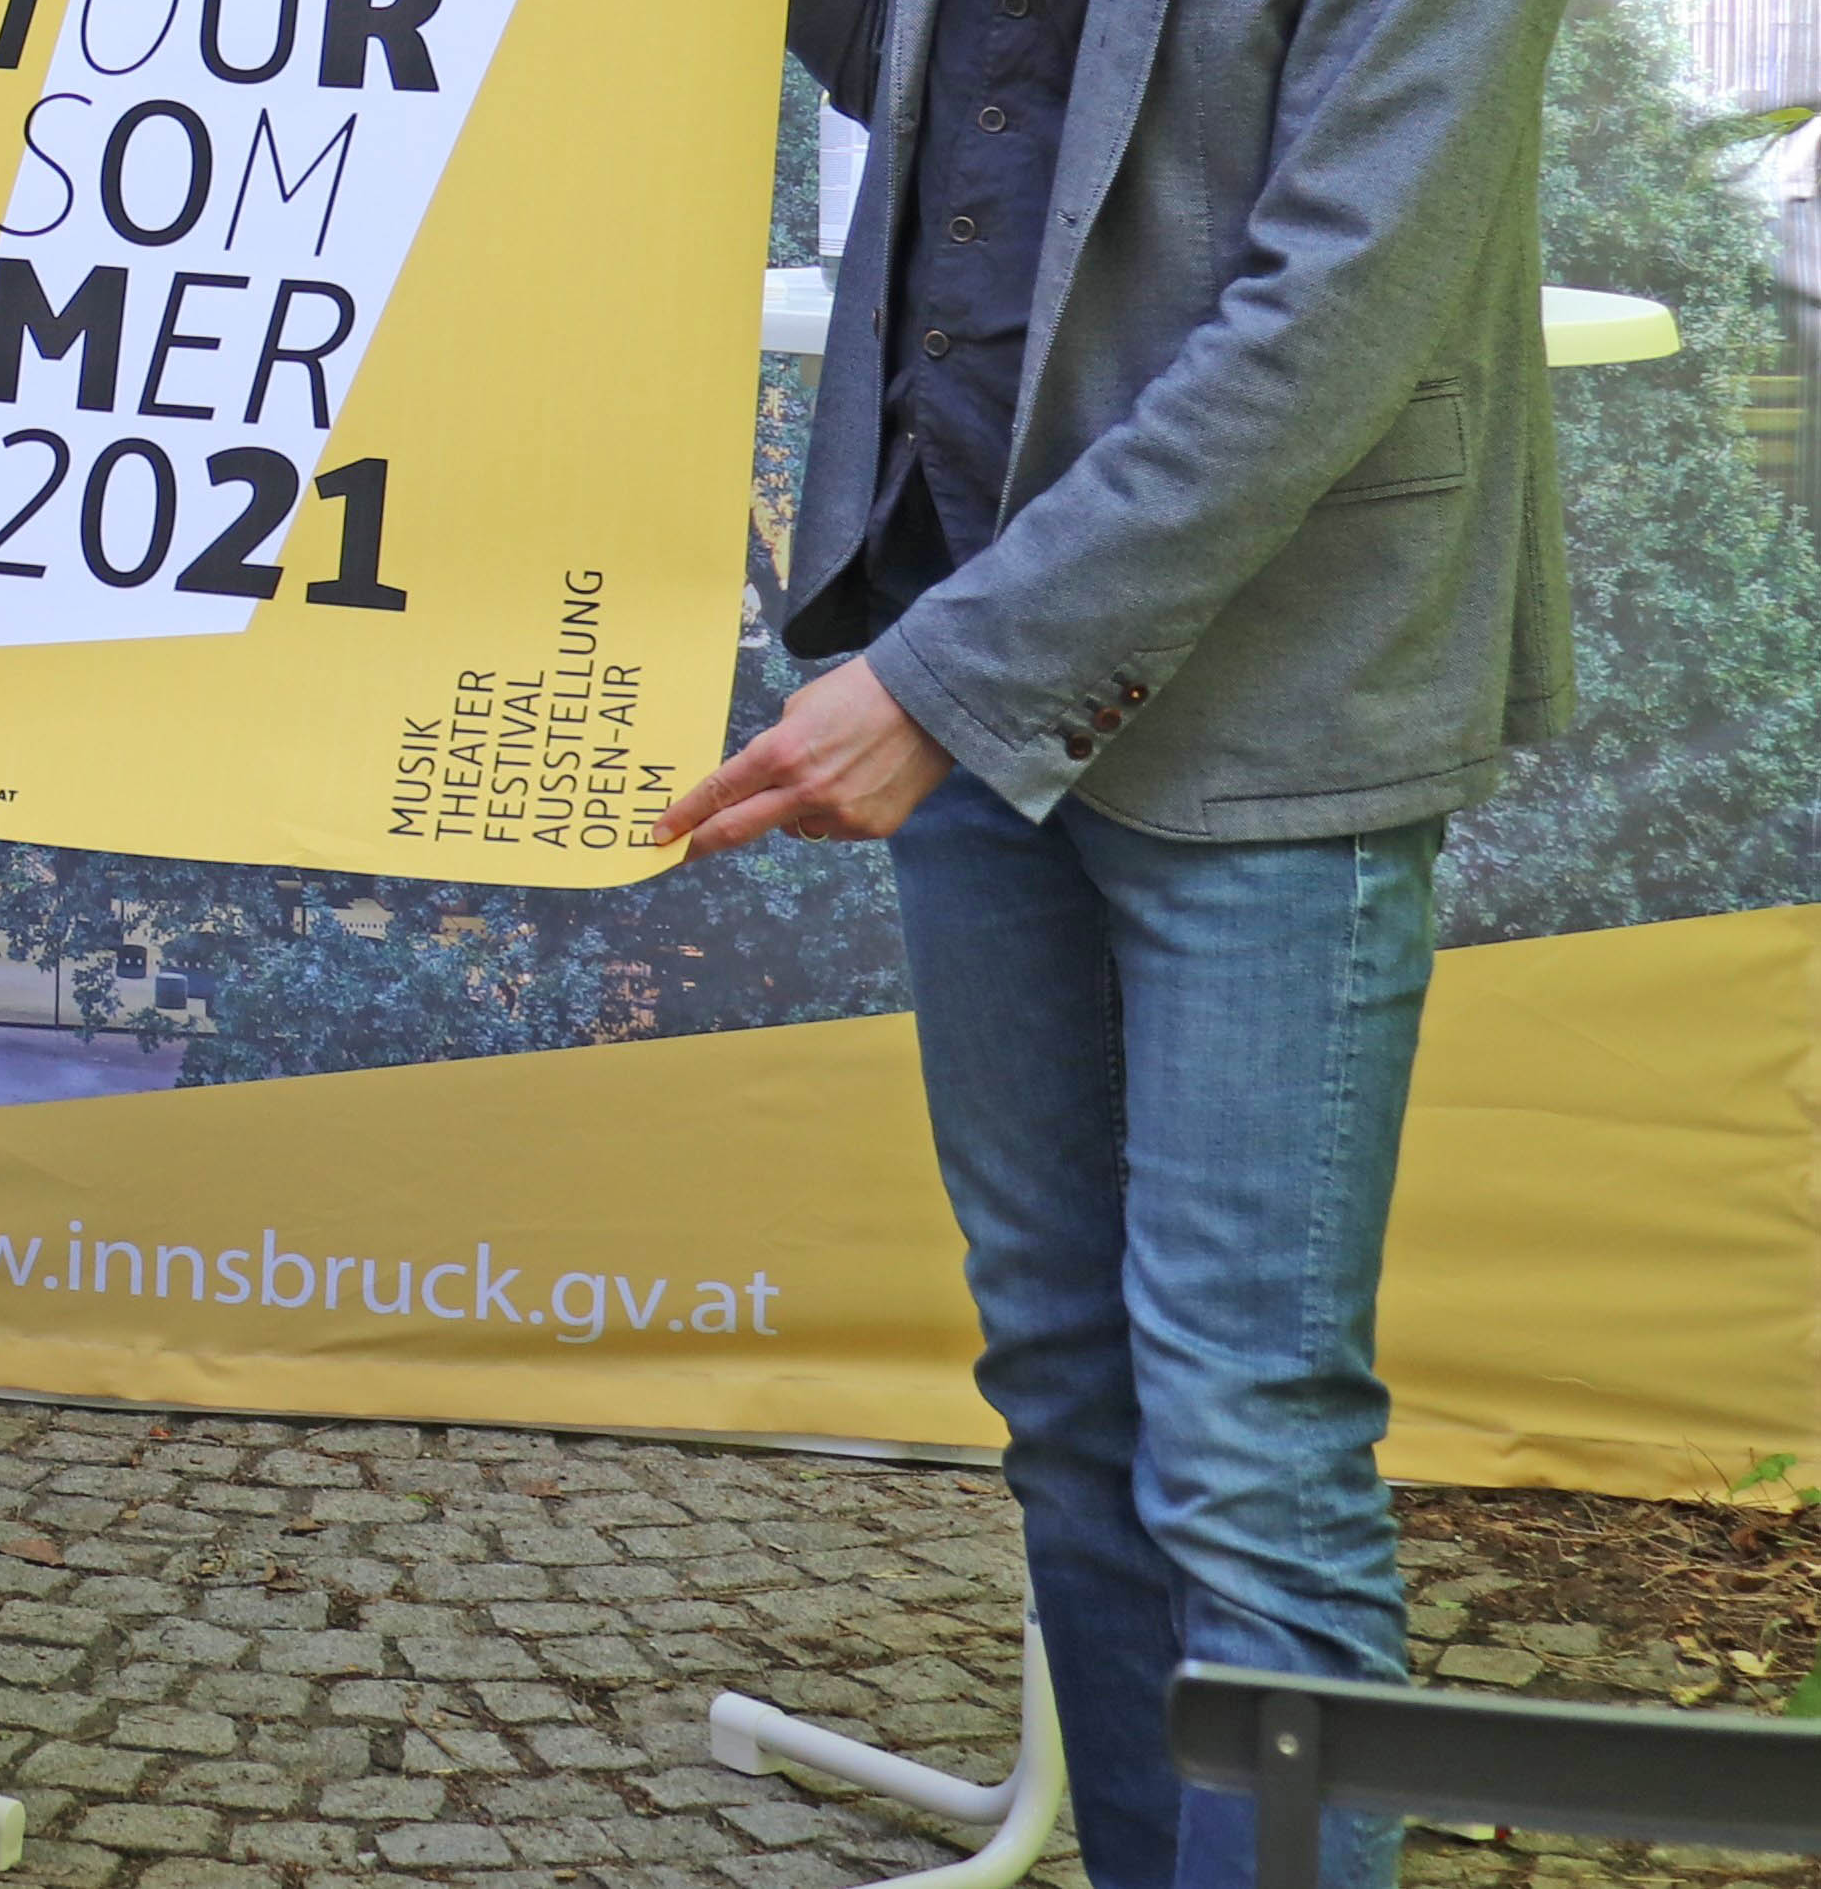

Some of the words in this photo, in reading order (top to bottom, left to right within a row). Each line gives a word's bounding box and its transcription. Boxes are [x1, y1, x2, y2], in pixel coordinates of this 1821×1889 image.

[387, 716, 442, 836] MUSIK
[434, 670, 496, 841] THEATER
[483, 670, 545, 843] FESTIVAL
[532, 570, 604, 849] AUSSTELLUNG
[579, 664, 642, 850] OPEN-AIR
[627, 765, 676, 849] FILM
